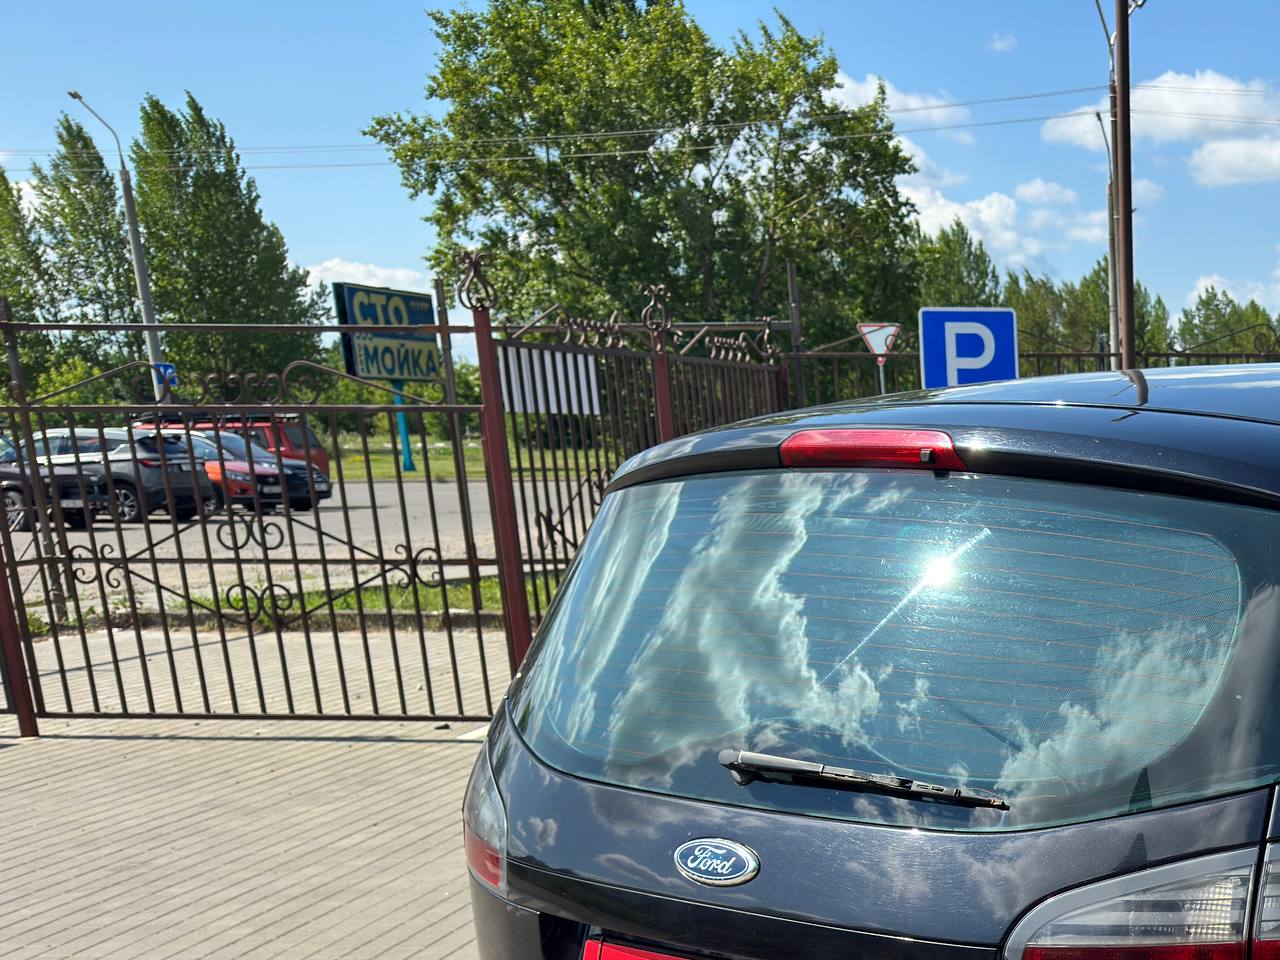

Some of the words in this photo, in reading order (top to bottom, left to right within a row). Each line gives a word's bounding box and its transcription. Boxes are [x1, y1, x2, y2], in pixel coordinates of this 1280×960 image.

[353, 291, 409, 326] СТО
[363, 343, 439, 377] МОЙКА
[944, 321, 996, 386] P
[687, 844, 737, 875] Ford
